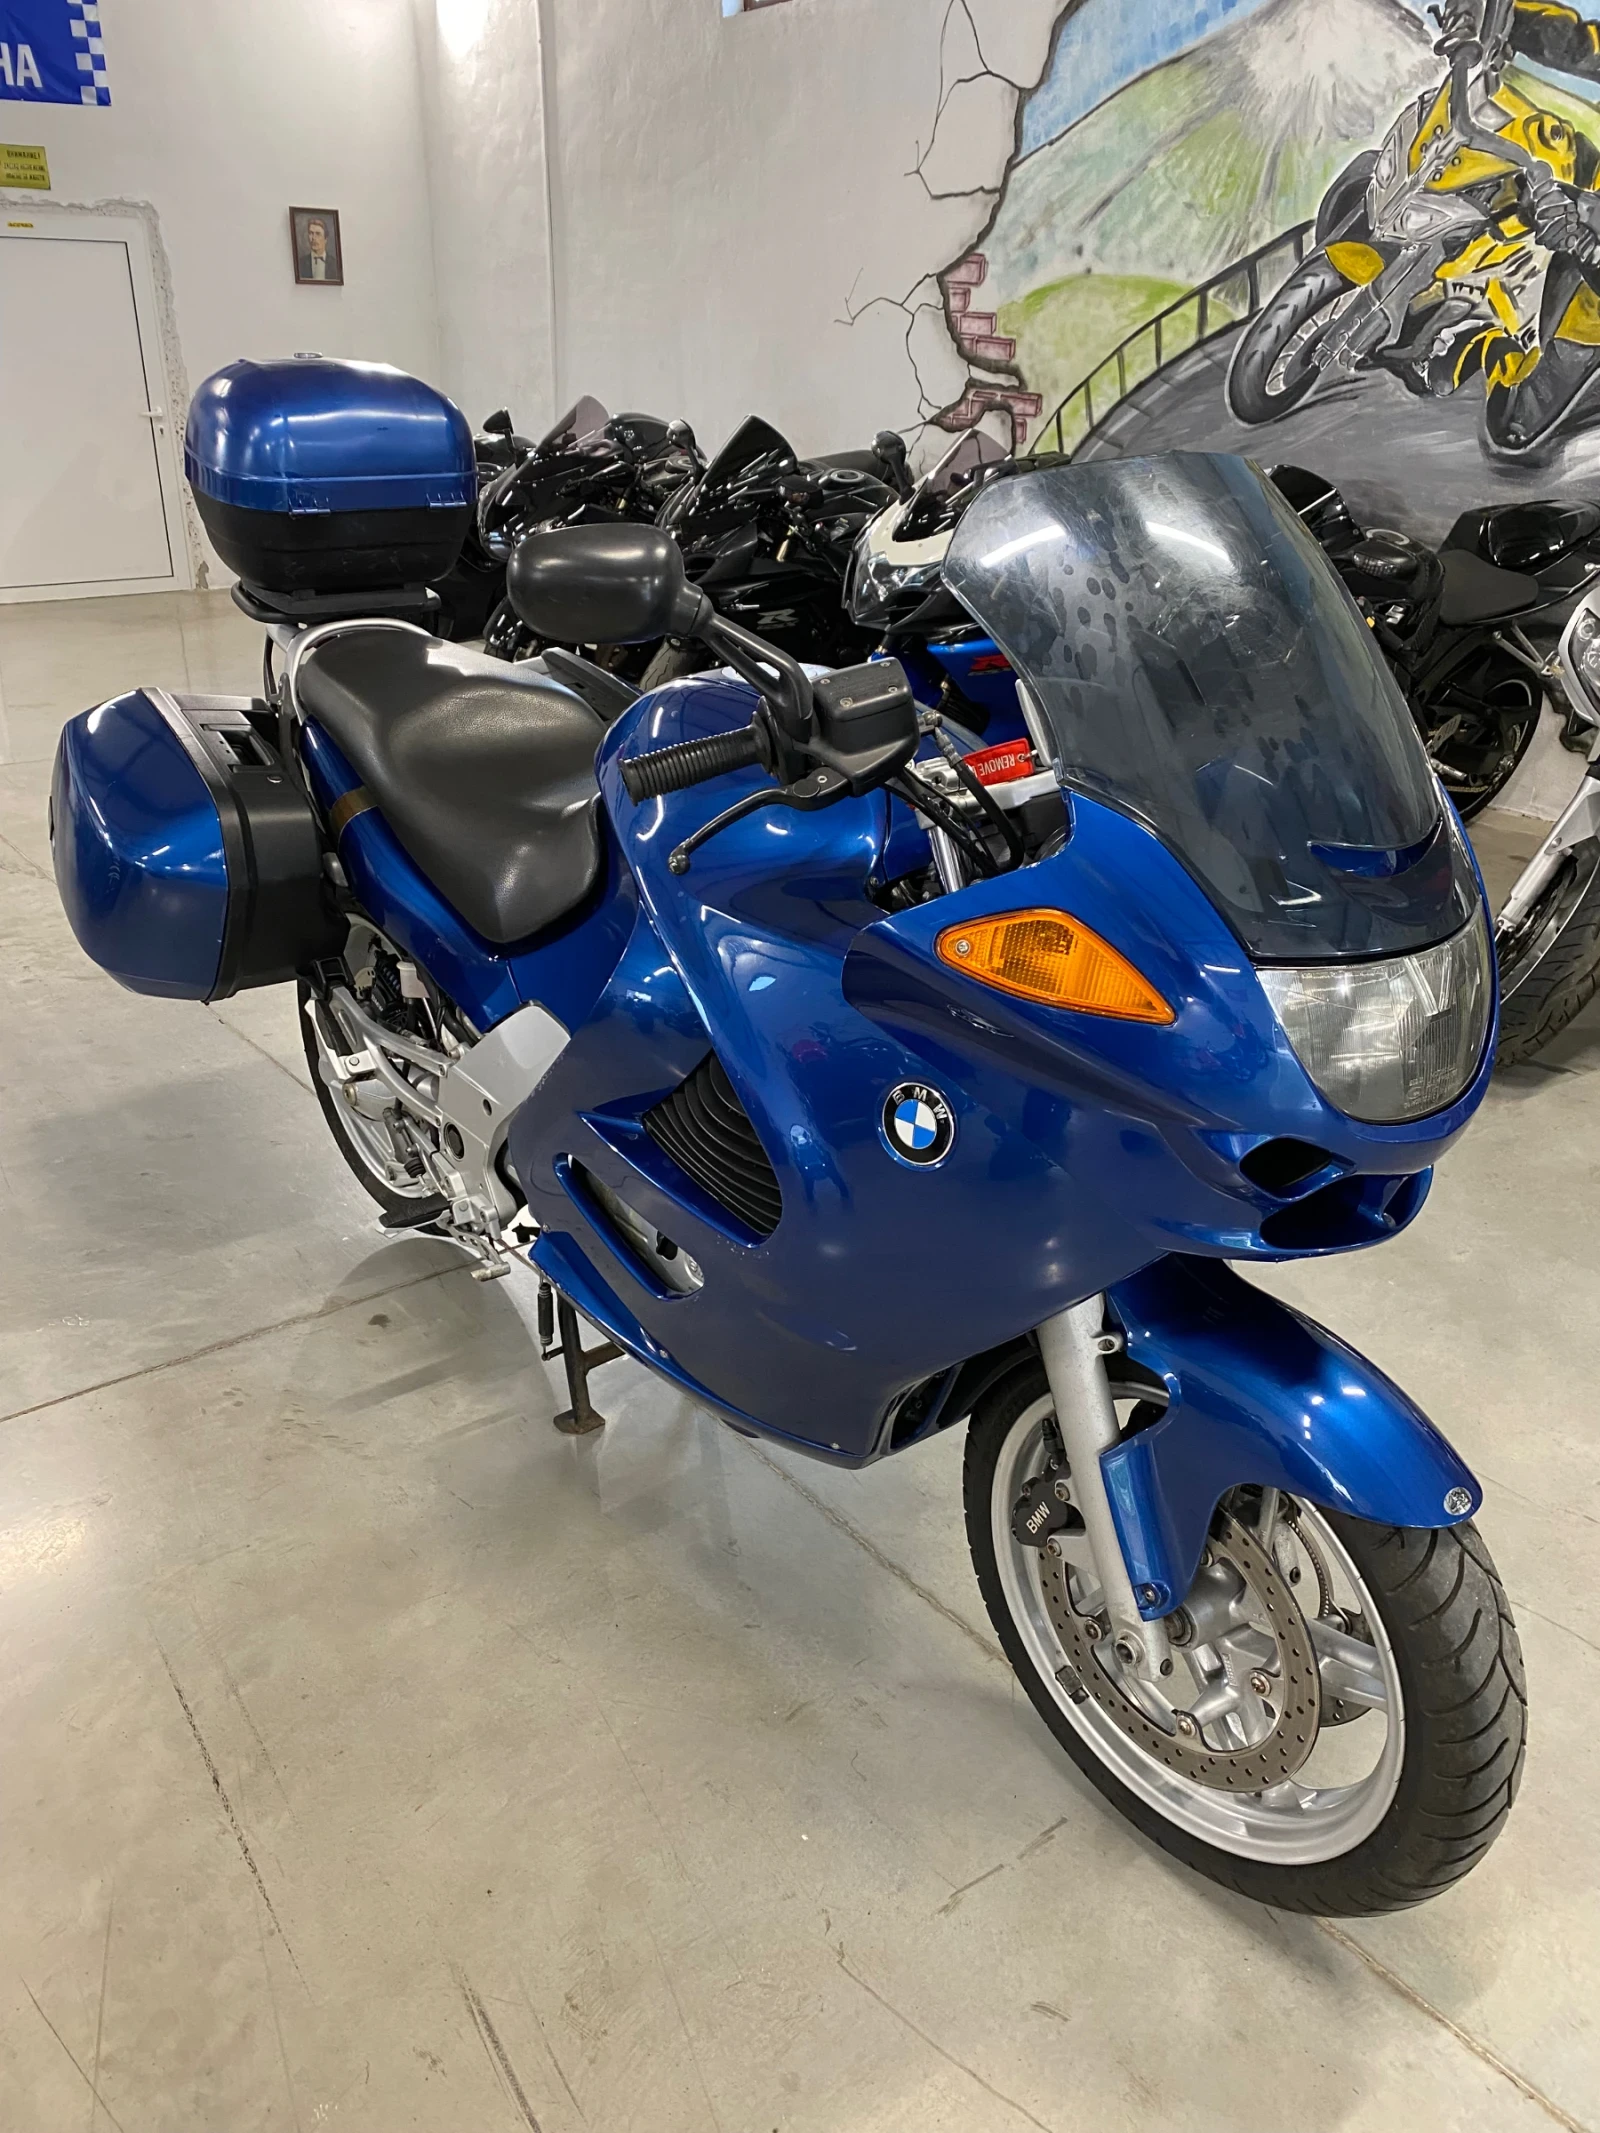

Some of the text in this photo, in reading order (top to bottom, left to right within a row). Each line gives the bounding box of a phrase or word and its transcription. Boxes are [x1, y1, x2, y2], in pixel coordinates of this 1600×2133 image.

[977, 753, 1016, 777] REMOVE
[892, 1086, 948, 1120] BMW
[1025, 1501, 1051, 1534] BMW
